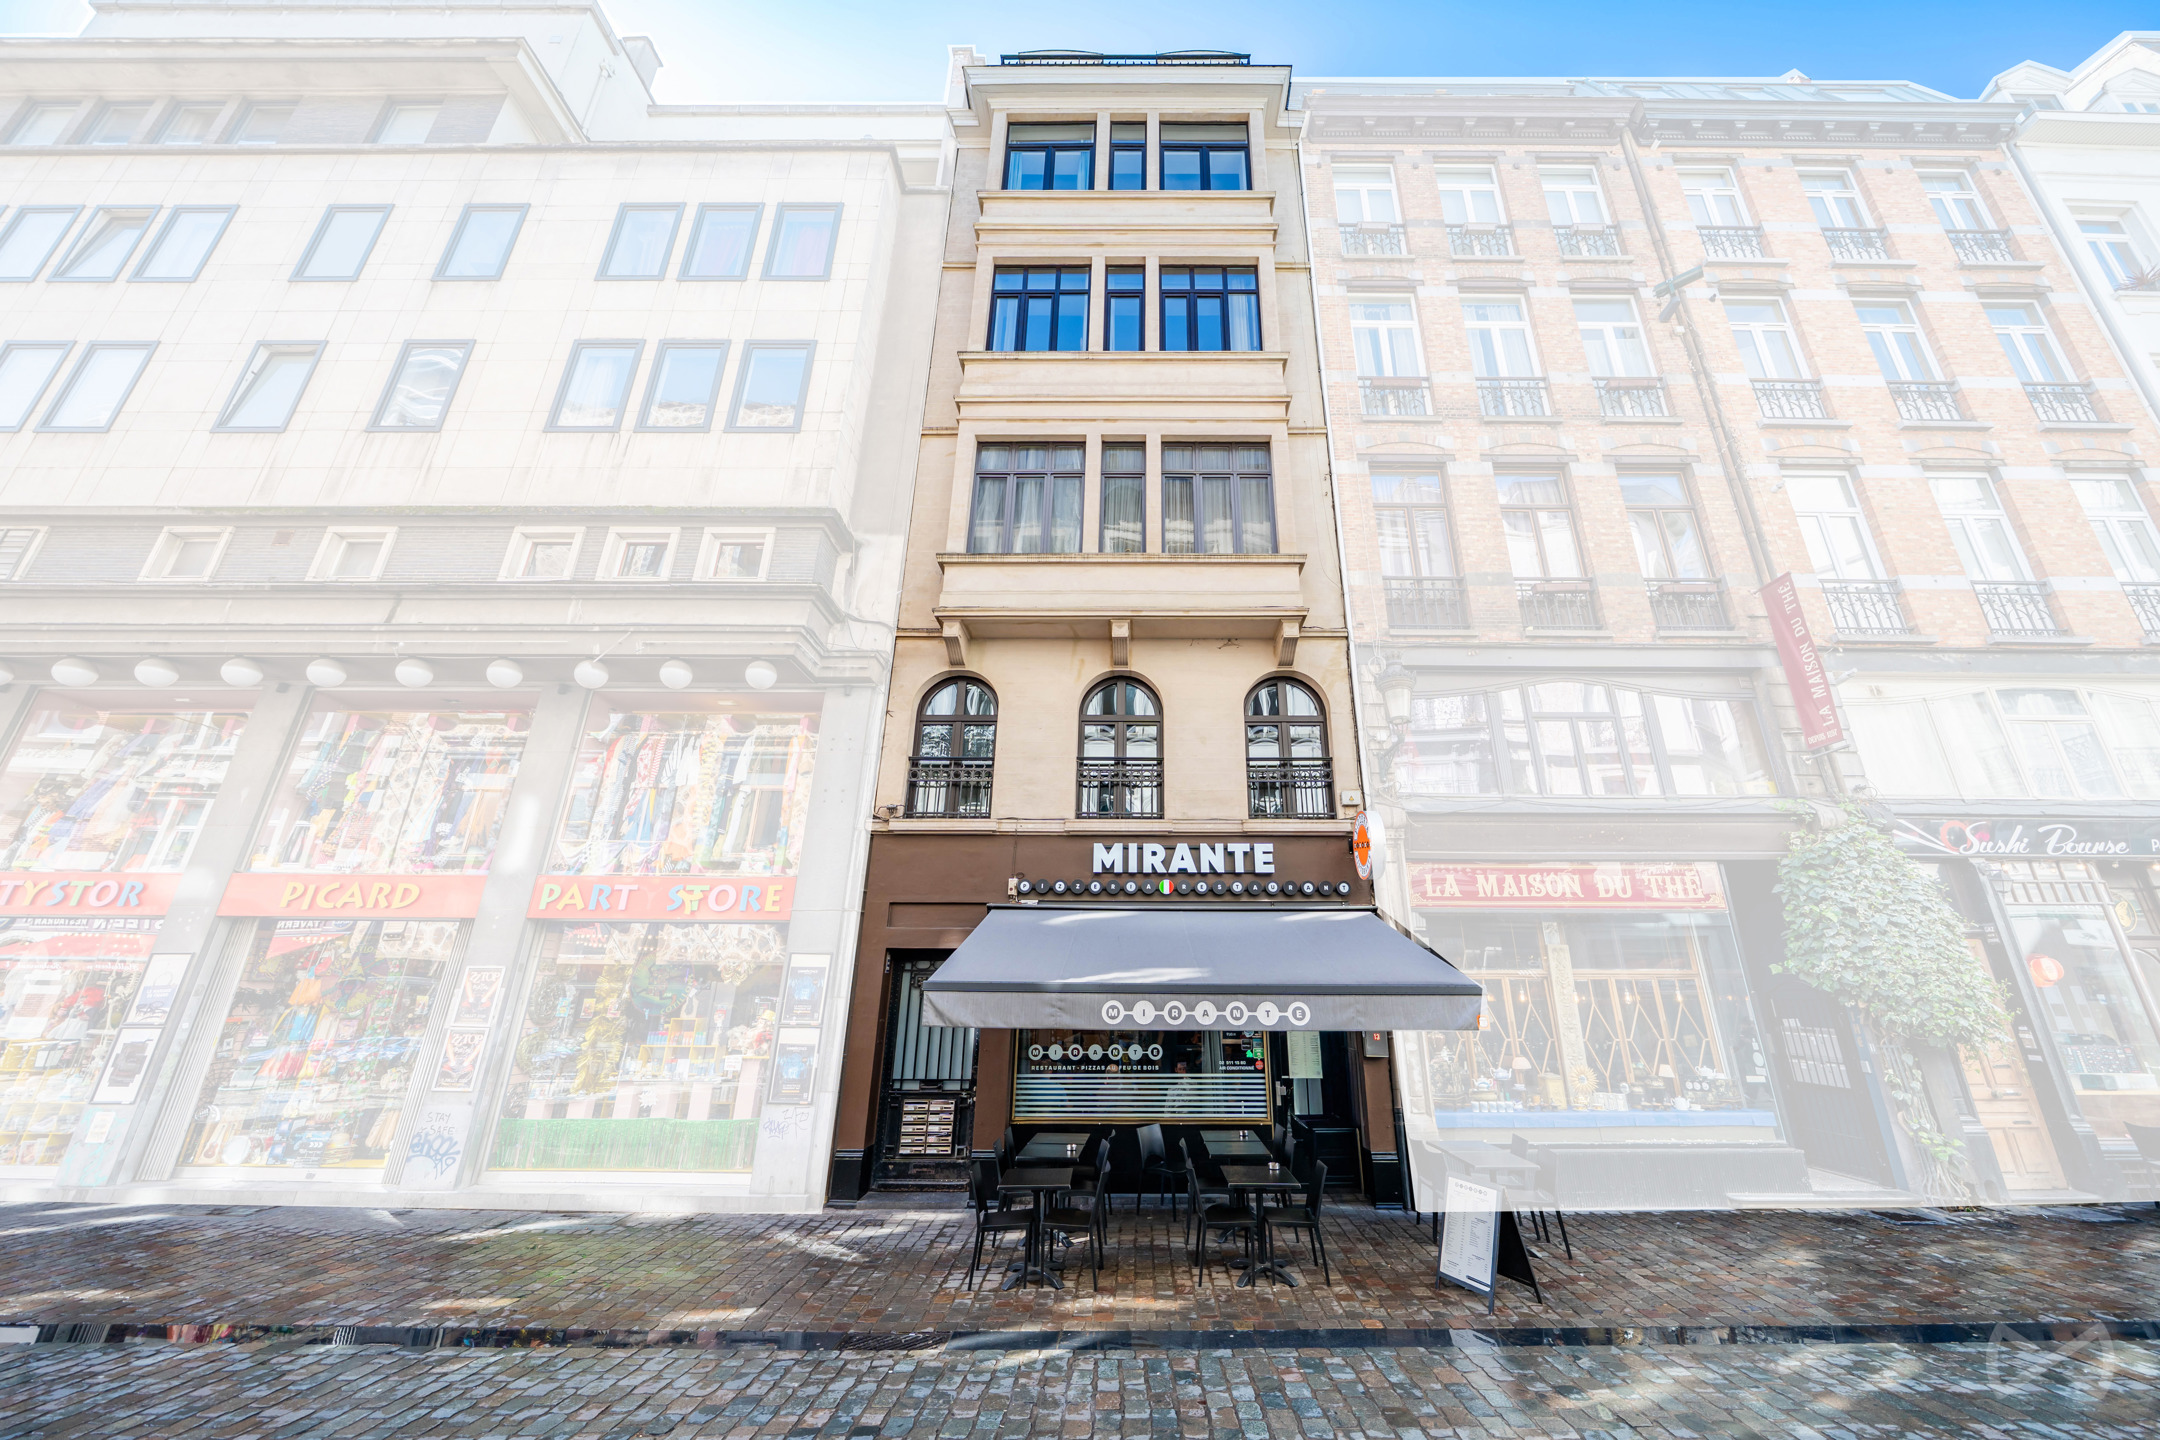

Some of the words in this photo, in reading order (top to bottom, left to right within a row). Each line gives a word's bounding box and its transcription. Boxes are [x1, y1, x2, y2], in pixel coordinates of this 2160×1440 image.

[1790, 616, 1806, 638] DU
[1799, 640, 1827, 699] MAISON
[1818, 704, 1835, 727] LA
[1959, 821, 2030, 855] Sushi
[2037, 823, 2130, 855] Bourse
[1092, 842, 1276, 874] MIRANTE
[279, 881, 421, 910] PICARD
[538, 883, 639, 911] PART
[1020, 881, 1154, 892] PIZZERIA
[1180, 882, 1348, 893] RESTAURANT
[1424, 873, 1464, 897] LA
[1474, 872, 1585, 899] MAISON
[1596, 874, 1634, 898] DU
[1105, 1005, 1307, 1021] MIRANTE
[426, 1111, 451, 1124] STAY
[428, 1125, 455, 1136] SAFE
